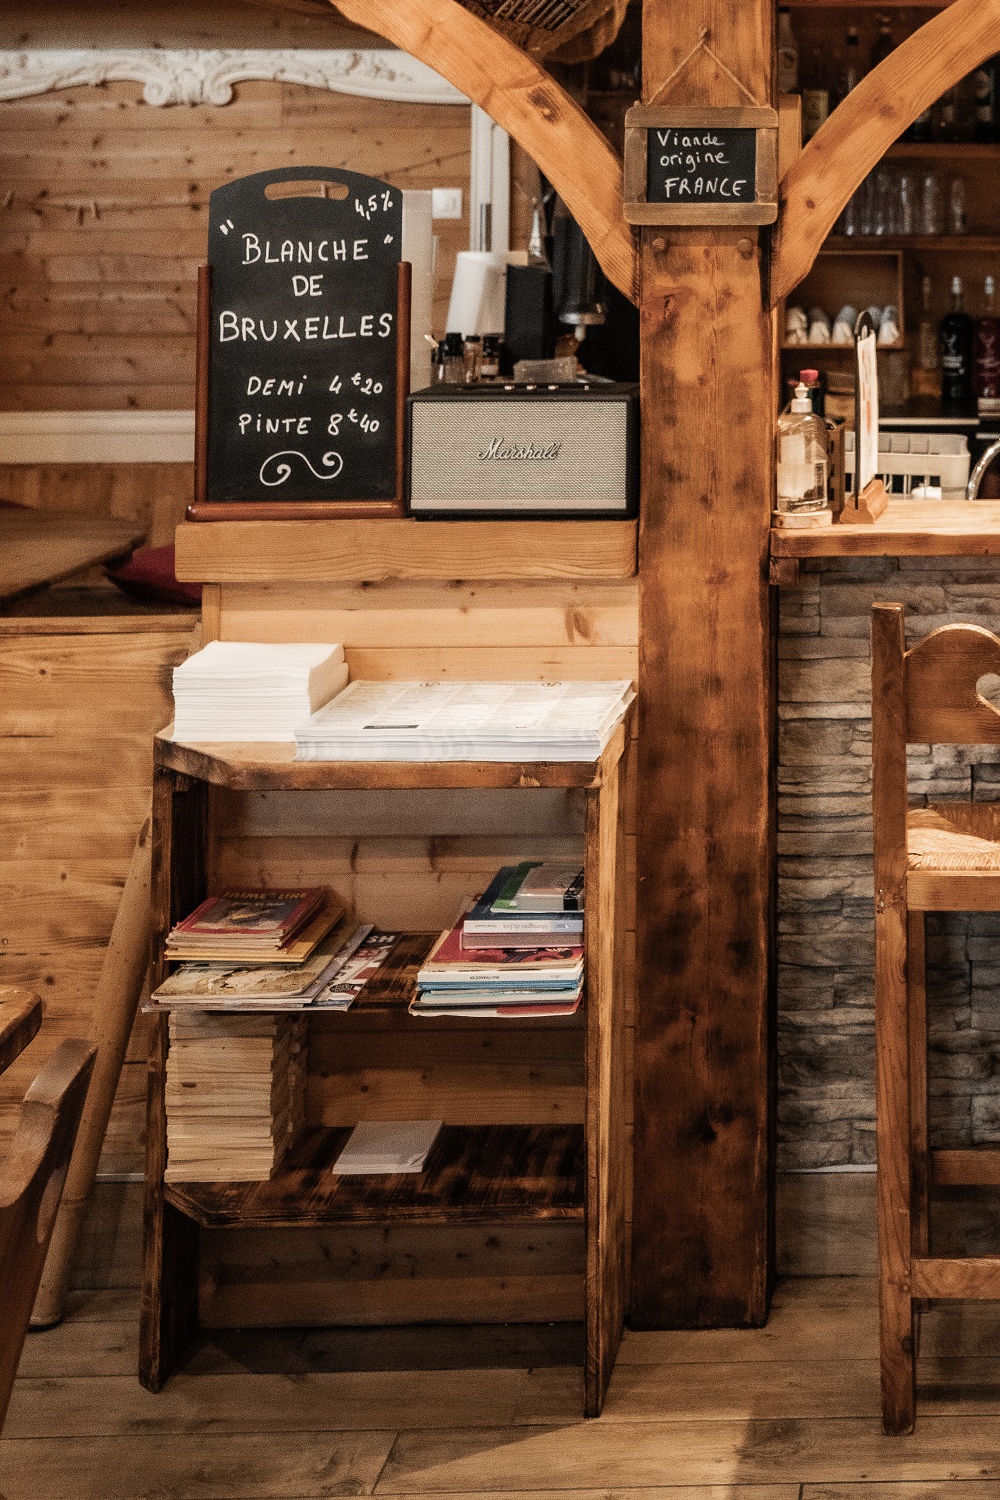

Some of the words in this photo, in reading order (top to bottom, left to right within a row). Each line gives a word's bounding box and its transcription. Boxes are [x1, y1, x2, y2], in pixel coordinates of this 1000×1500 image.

[656, 130, 726, 147] Viande
[660, 151, 730, 173] origine
[664, 177, 747, 198] FRANCE
[292, 274, 323, 297] DE
[219, 310, 393, 342] BRUXELLES
[477, 437, 562, 460] Marshall
